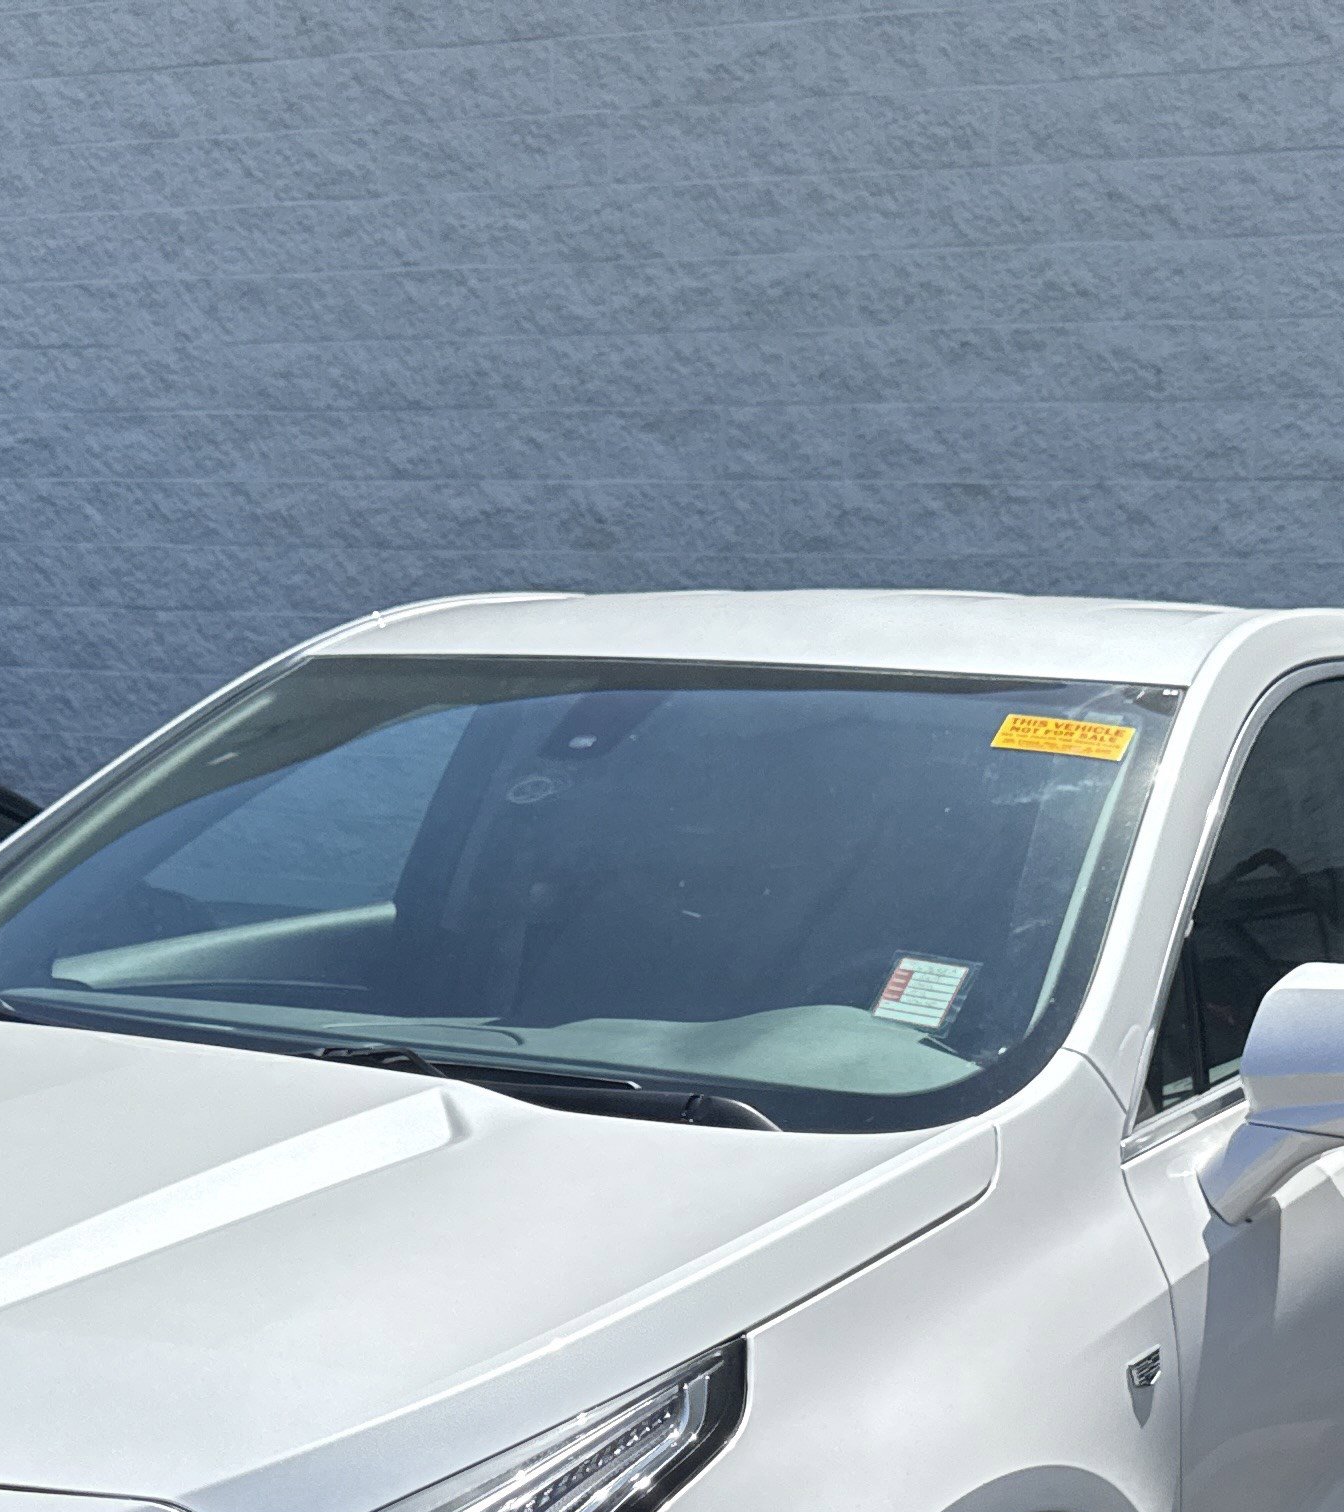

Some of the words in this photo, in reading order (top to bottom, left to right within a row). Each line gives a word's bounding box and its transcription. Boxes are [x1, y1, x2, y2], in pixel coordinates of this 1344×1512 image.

[1009, 726, 1039, 735] NOT
[1044, 729, 1075, 737] FOR
[1079, 732, 1118, 743] SALE
[1011, 717, 1049, 728] THIS
[1053, 721, 1126, 738] VEHICLE
